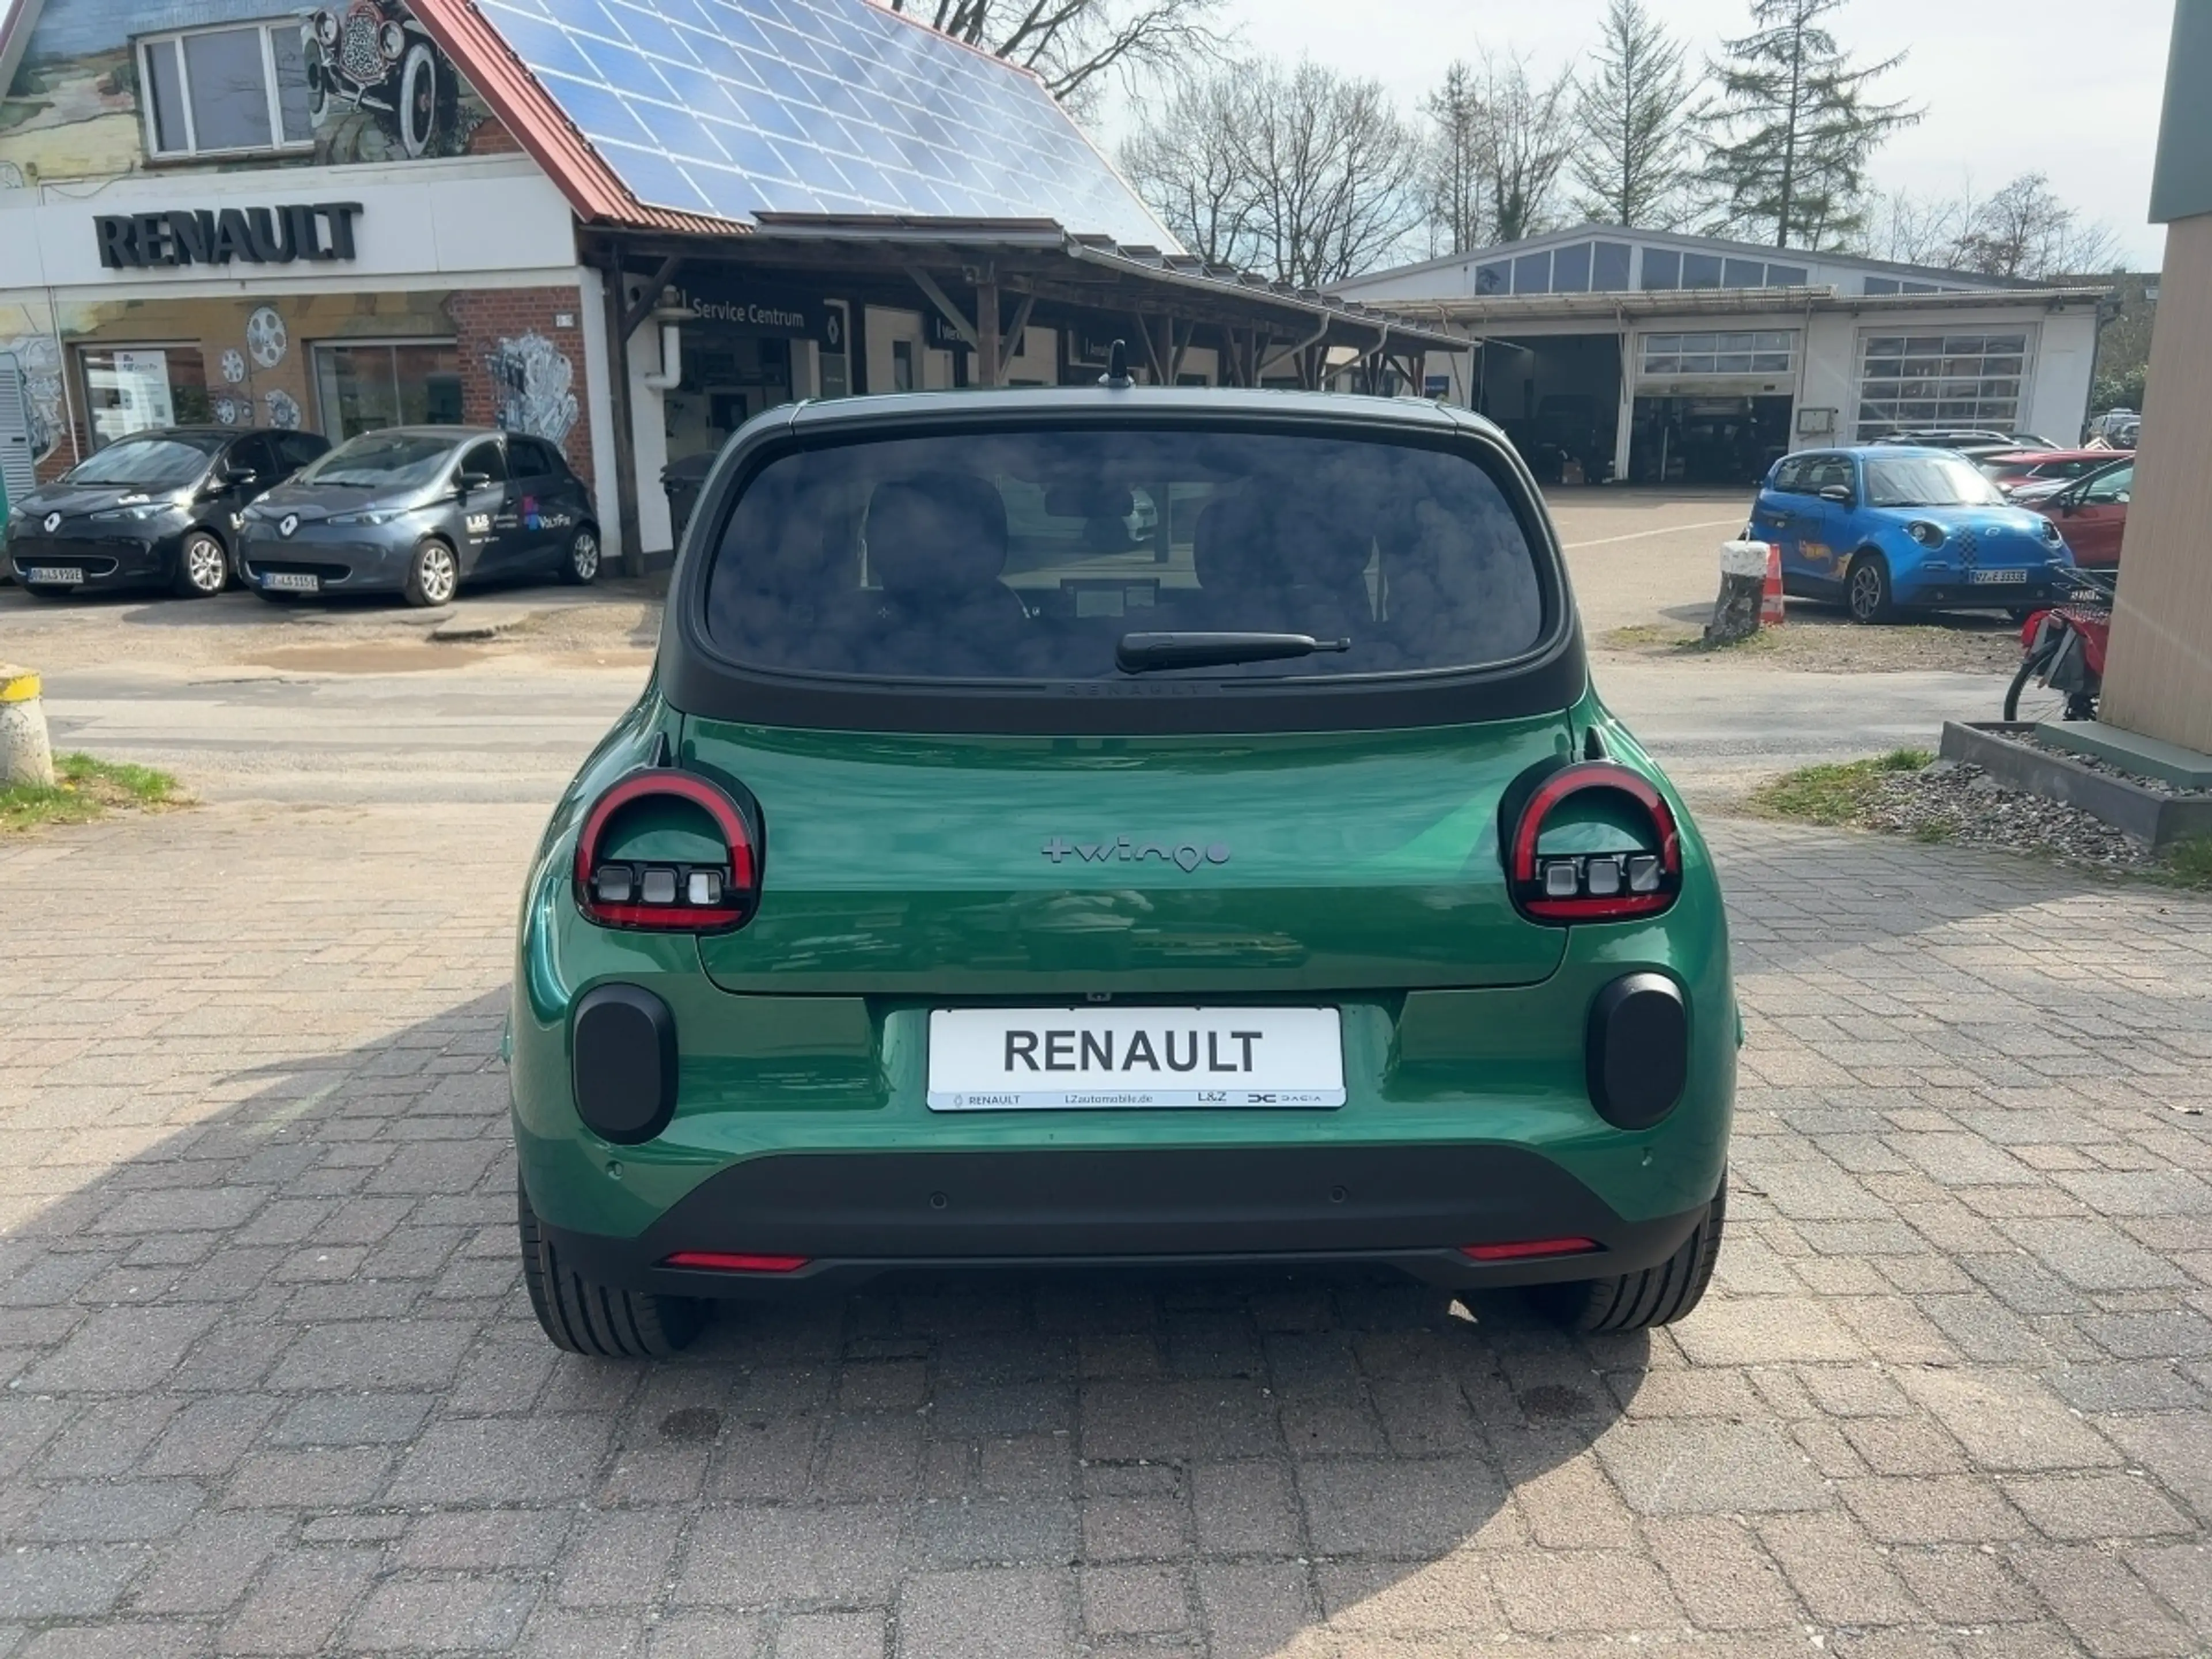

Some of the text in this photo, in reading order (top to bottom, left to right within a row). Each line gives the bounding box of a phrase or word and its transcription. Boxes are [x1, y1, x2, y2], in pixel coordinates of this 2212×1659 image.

[92, 202, 364, 268] RENAULT
[693, 297, 805, 328] Service Centrum
[1005, 1029, 1264, 1072] RENAULT
[968, 1095, 1021, 1105] RENAULT
[1065, 1094, 1154, 1104] LZautomobile.de
[1197, 1092, 1227, 1102] L&Z
